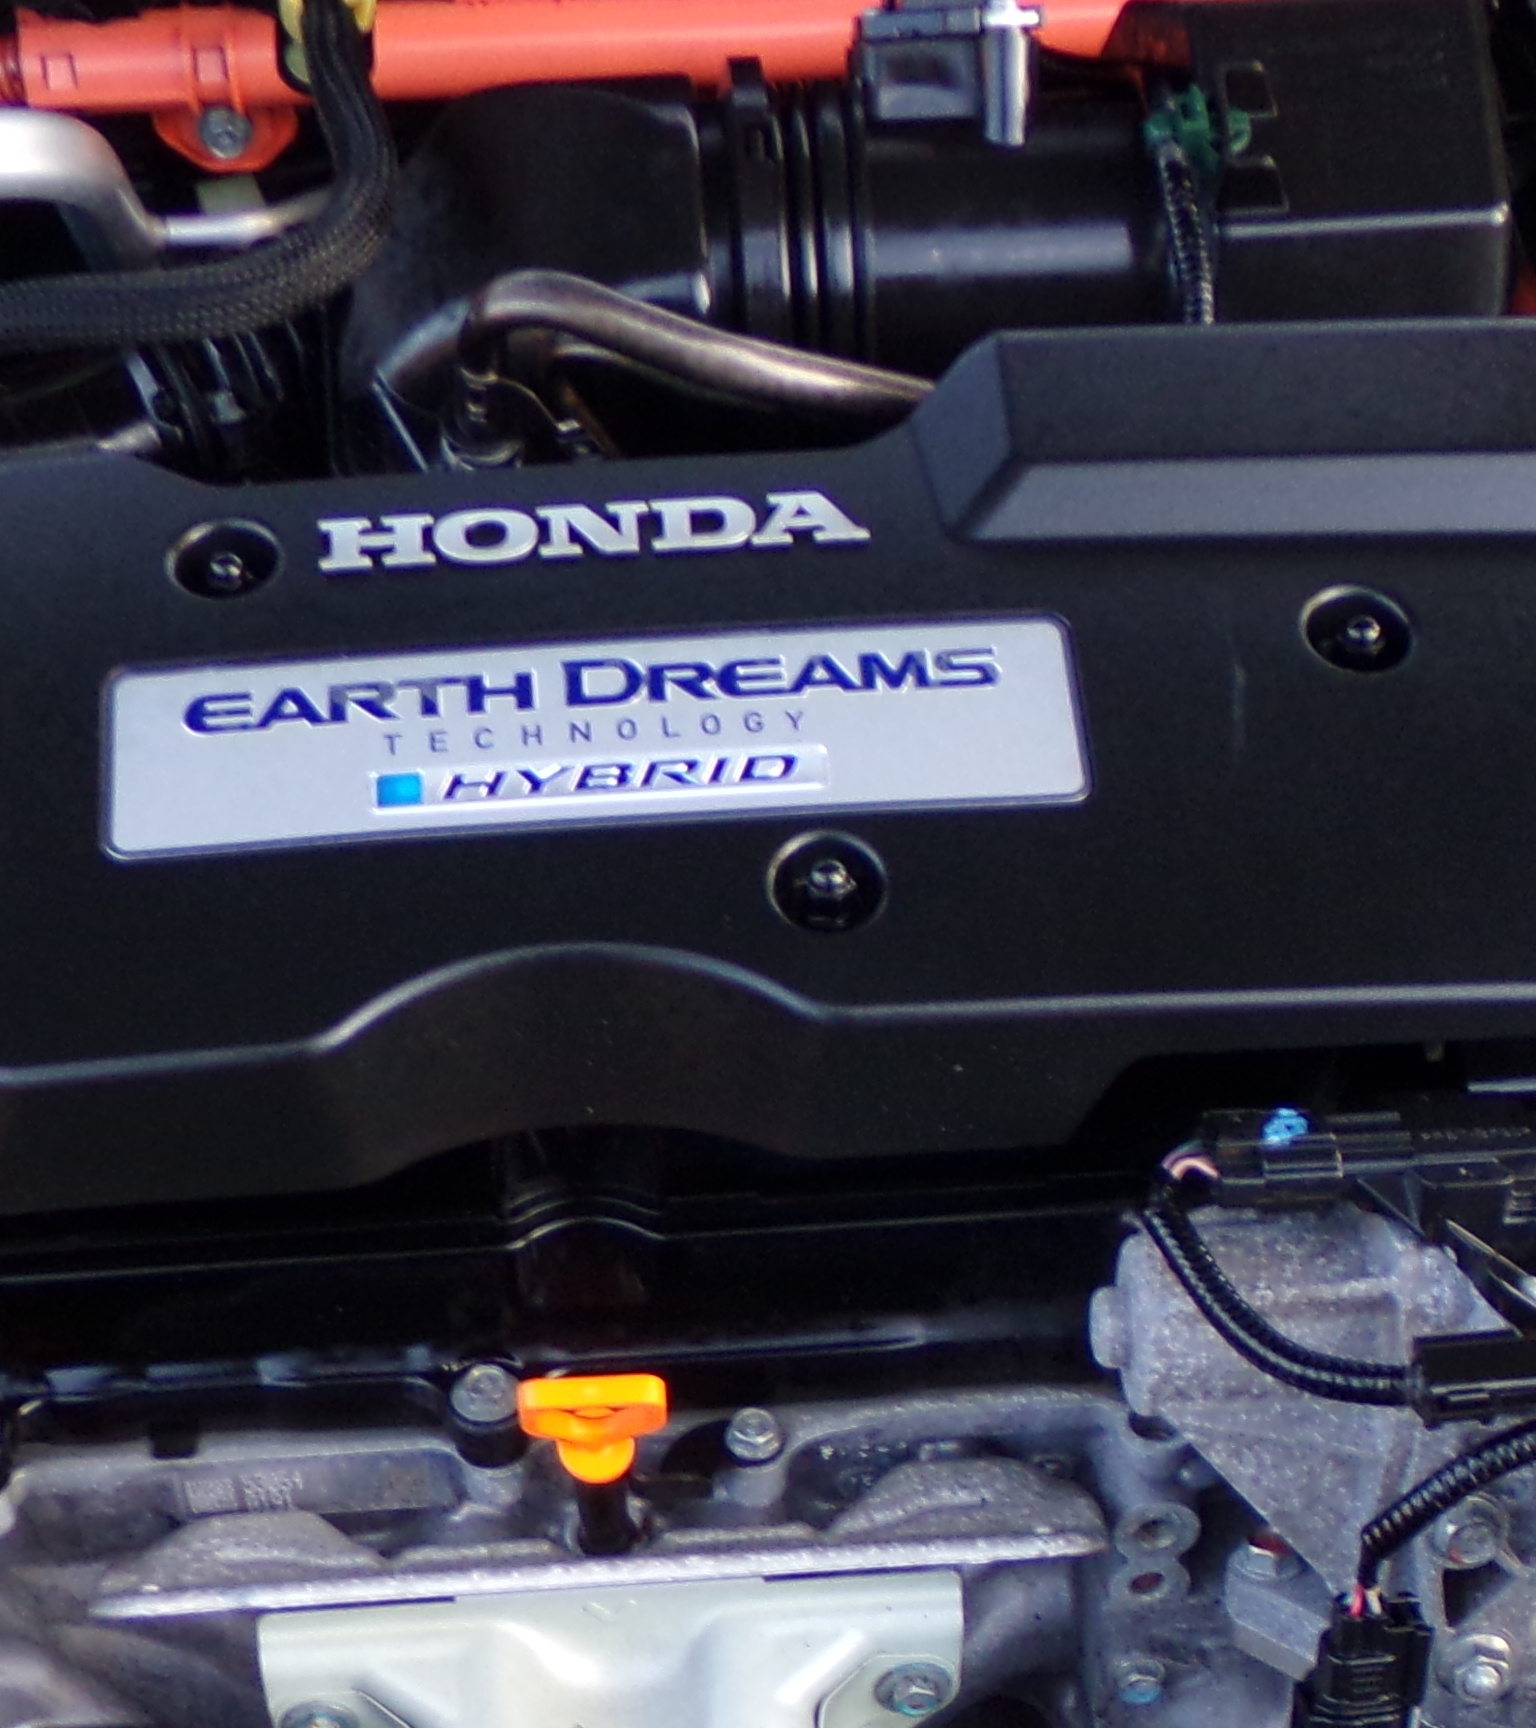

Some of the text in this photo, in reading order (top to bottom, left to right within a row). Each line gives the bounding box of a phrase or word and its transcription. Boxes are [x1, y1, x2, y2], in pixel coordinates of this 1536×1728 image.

[318, 490, 869, 575] HONDA
[182, 646, 1000, 735] EARTH DREAMS
[383, 711, 805, 756] TECHNOLOGY
[442, 753, 800, 801] HYBRID
